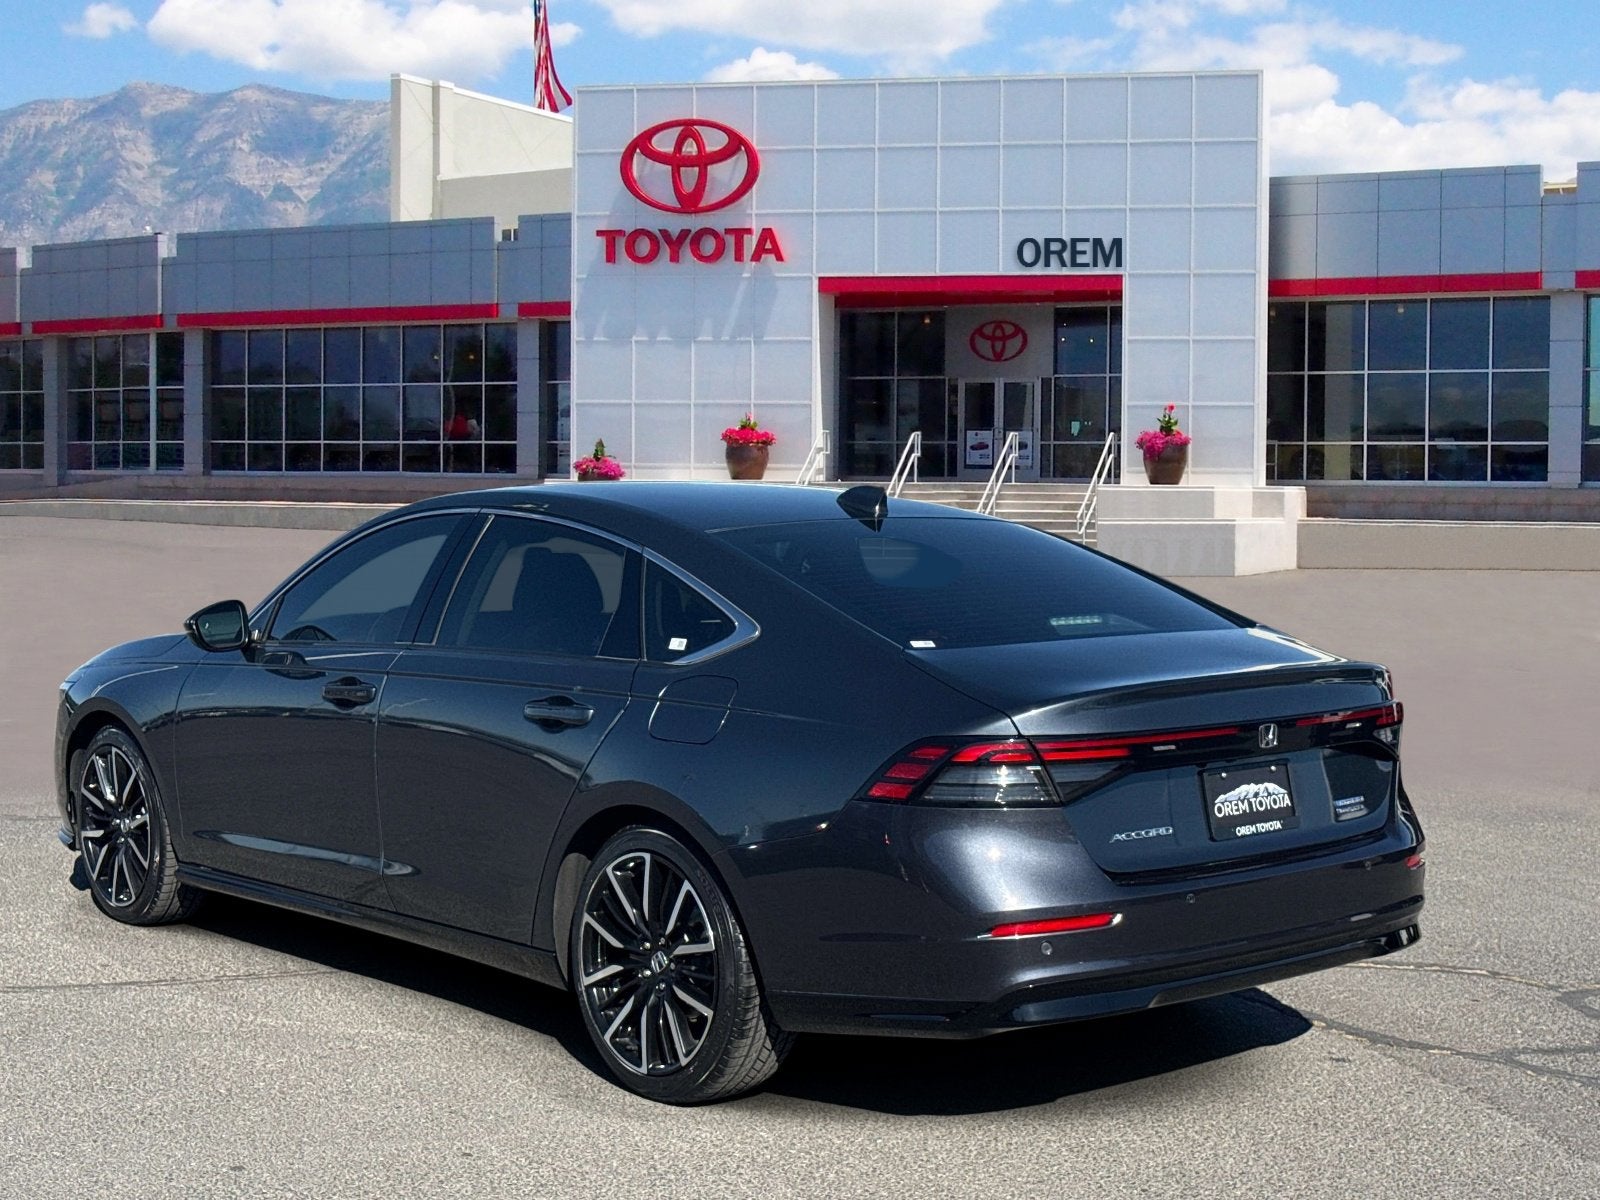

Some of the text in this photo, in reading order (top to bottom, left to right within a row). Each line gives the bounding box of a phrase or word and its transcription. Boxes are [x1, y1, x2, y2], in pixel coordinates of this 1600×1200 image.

[596, 227, 785, 264] TOYOTA
[1016, 237, 1123, 268] OREM
[1214, 793, 1292, 818] OREM TOYOTA
[1108, 826, 1174, 844] ACCORD
[1235, 820, 1282, 837] OREM TOYOTA
